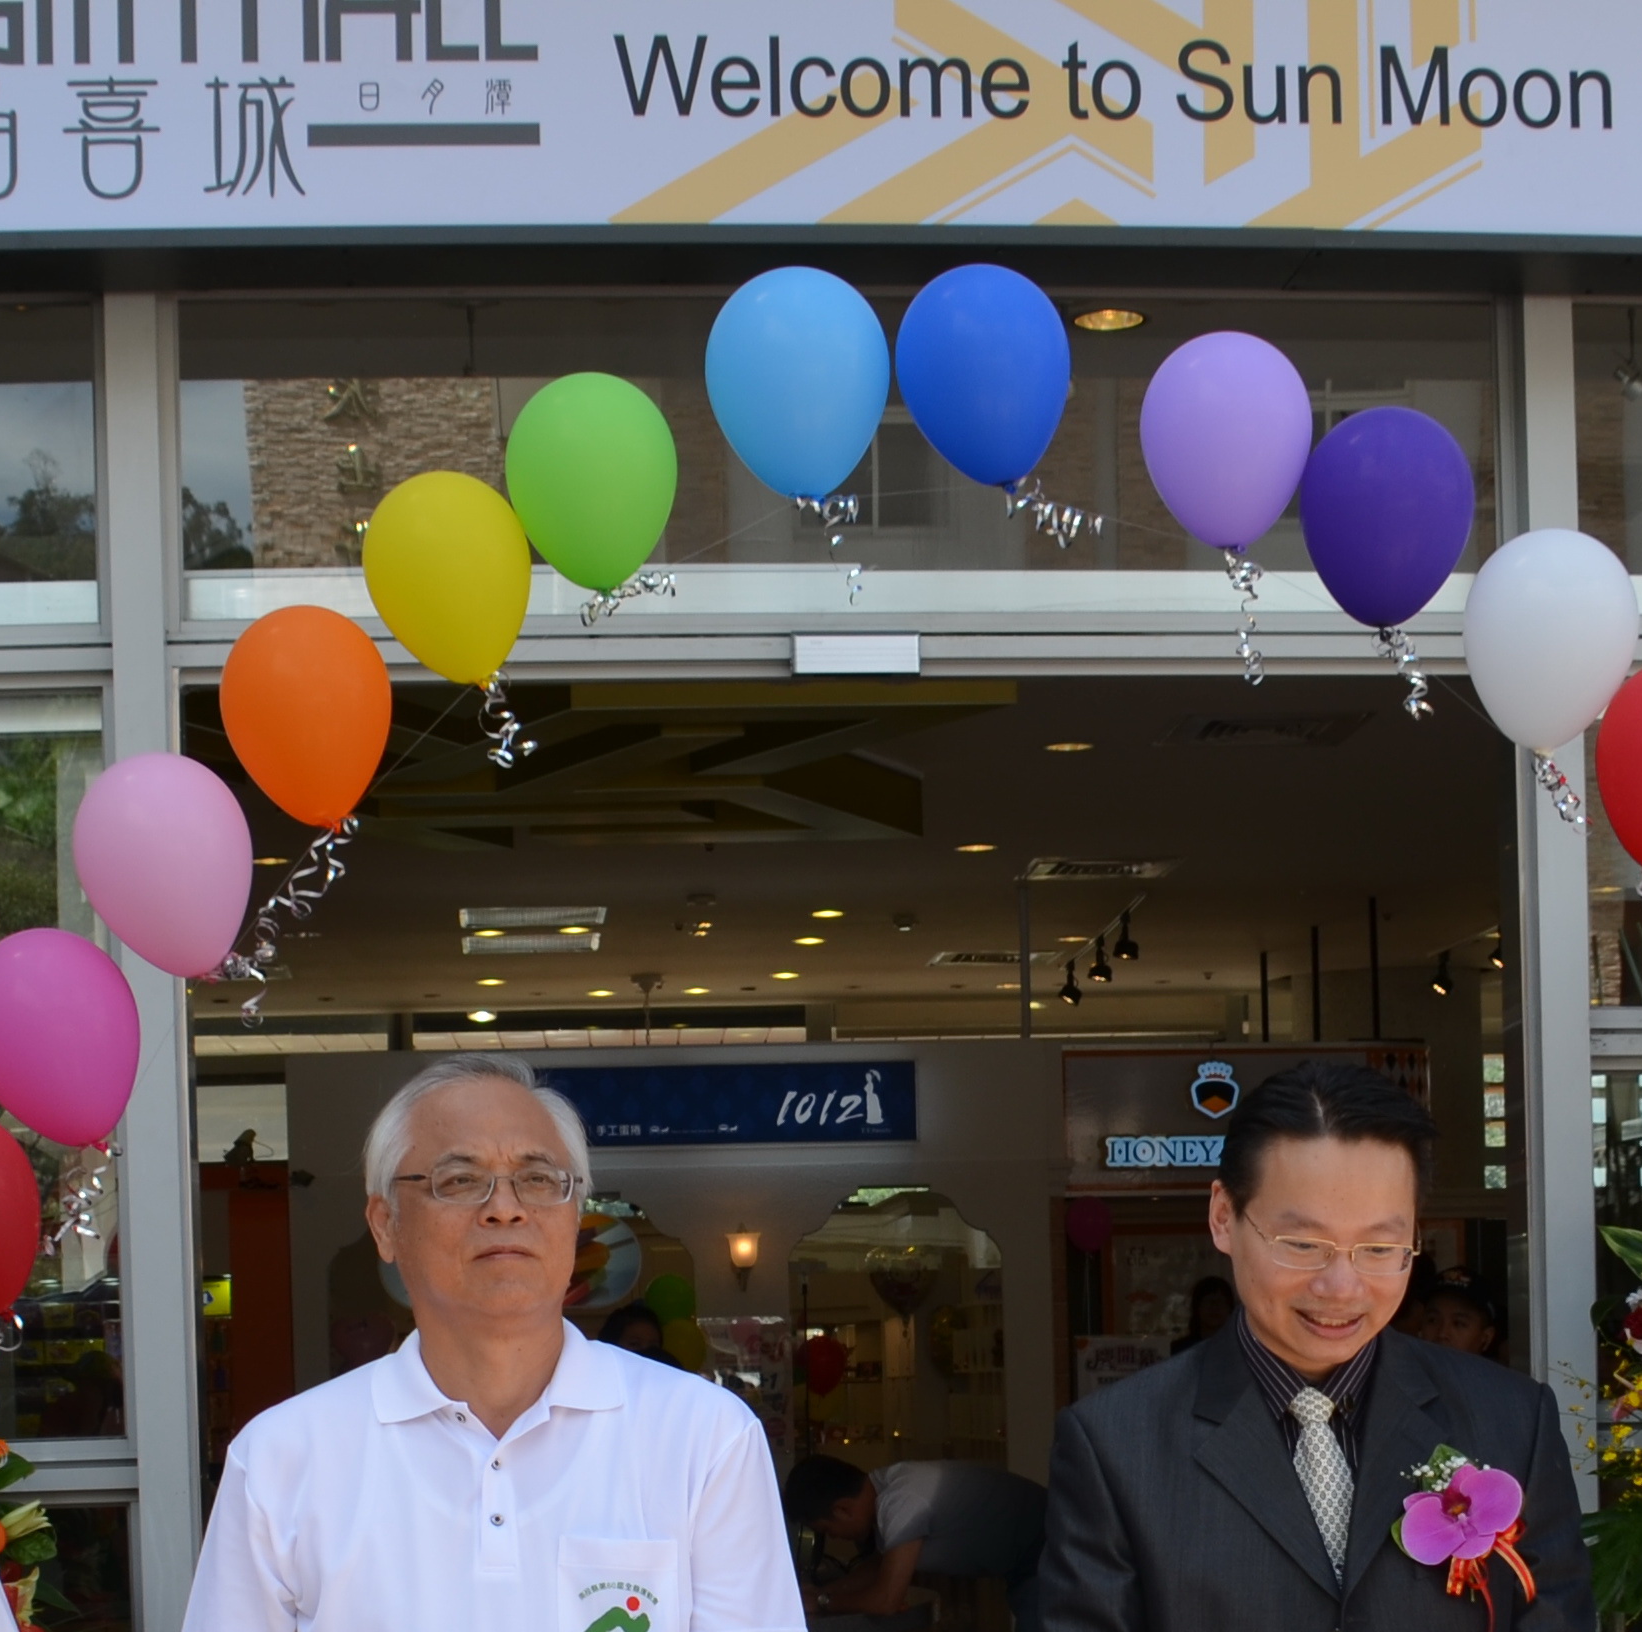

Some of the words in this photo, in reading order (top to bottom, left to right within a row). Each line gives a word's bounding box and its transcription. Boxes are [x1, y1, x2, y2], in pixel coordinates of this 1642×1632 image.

[359, 77, 513, 115] 日月潭
[613, 35, 1030, 121] Welcome
[1062, 41, 1141, 121] to
[1176, 39, 1343, 125] Sun
[1379, 45, 1613, 129] Moon
[776, 1089, 864, 1127] 1012
